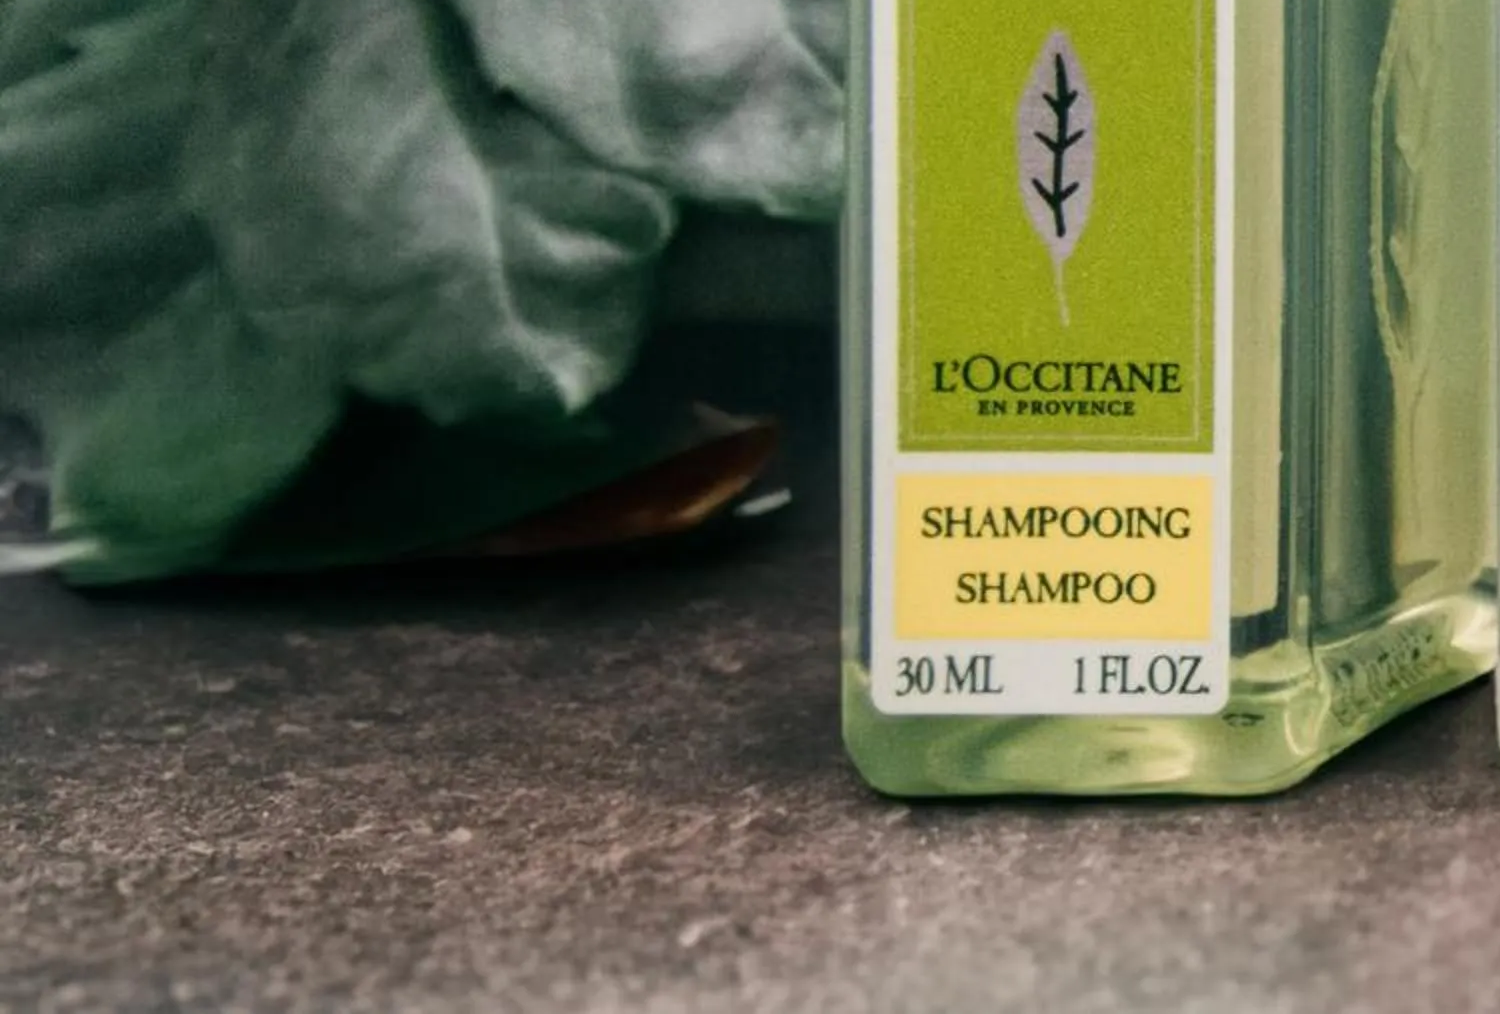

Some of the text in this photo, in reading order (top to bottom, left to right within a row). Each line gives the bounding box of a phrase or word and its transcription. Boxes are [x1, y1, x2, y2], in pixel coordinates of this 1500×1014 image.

[933, 353, 1183, 394] L'OCCITANE
[977, 399, 1136, 417] EN PROVENCE
[921, 505, 1191, 539] SHAMPOOING
[955, 571, 1157, 605] SHAMPOO
[895, 655, 1004, 697] 30 ML
[1073, 657, 1087, 694] 1
